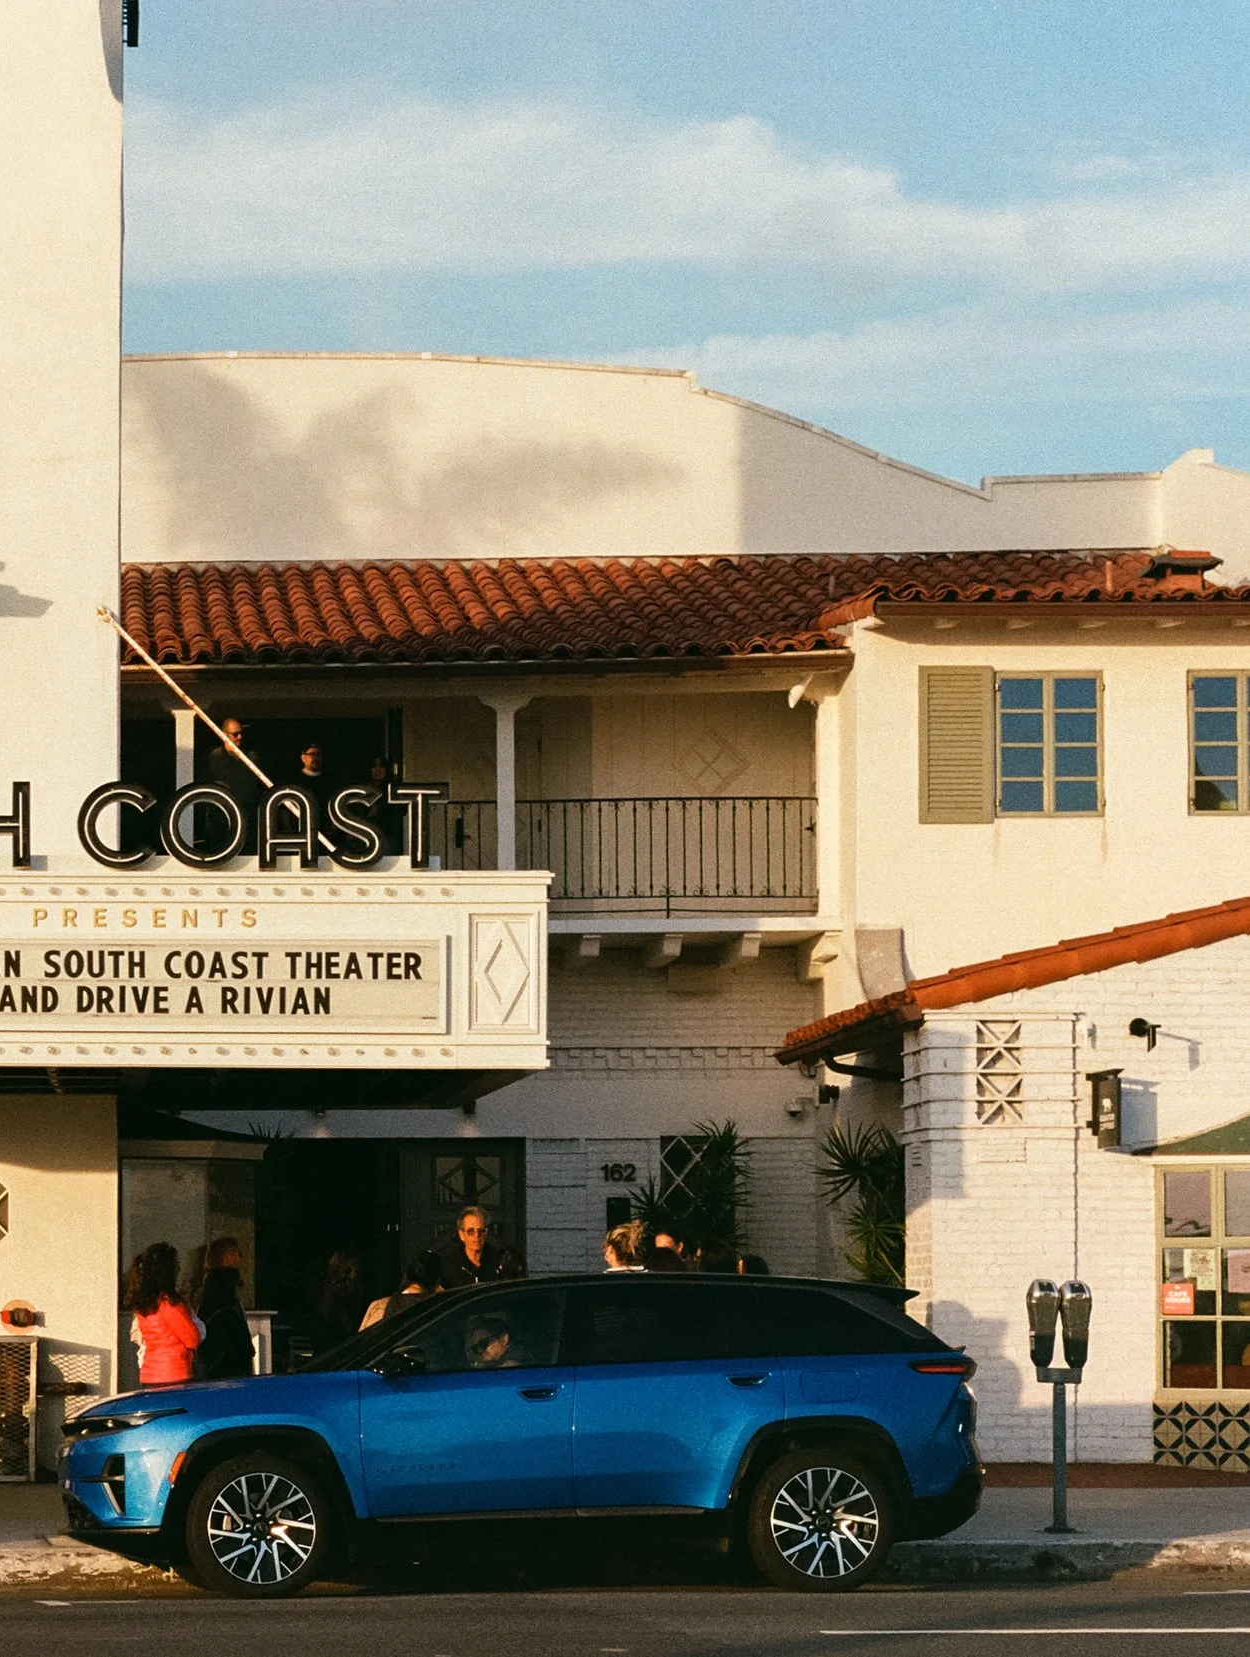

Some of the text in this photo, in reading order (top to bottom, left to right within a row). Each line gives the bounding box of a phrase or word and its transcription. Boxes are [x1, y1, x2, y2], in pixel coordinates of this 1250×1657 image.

[77, 780, 450, 869] COAST
[32, 908, 257, 928] PRESENTS
[44, 950, 146, 979] SOUTH
[164, 950, 268, 980] COAST
[285, 951, 423, 980] THEATER
[77, 986, 169, 1014] DRIVE
[184, 986, 205, 1014] A
[221, 986, 331, 1015] RIVIAN
[601, 1163, 637, 1182] 162
